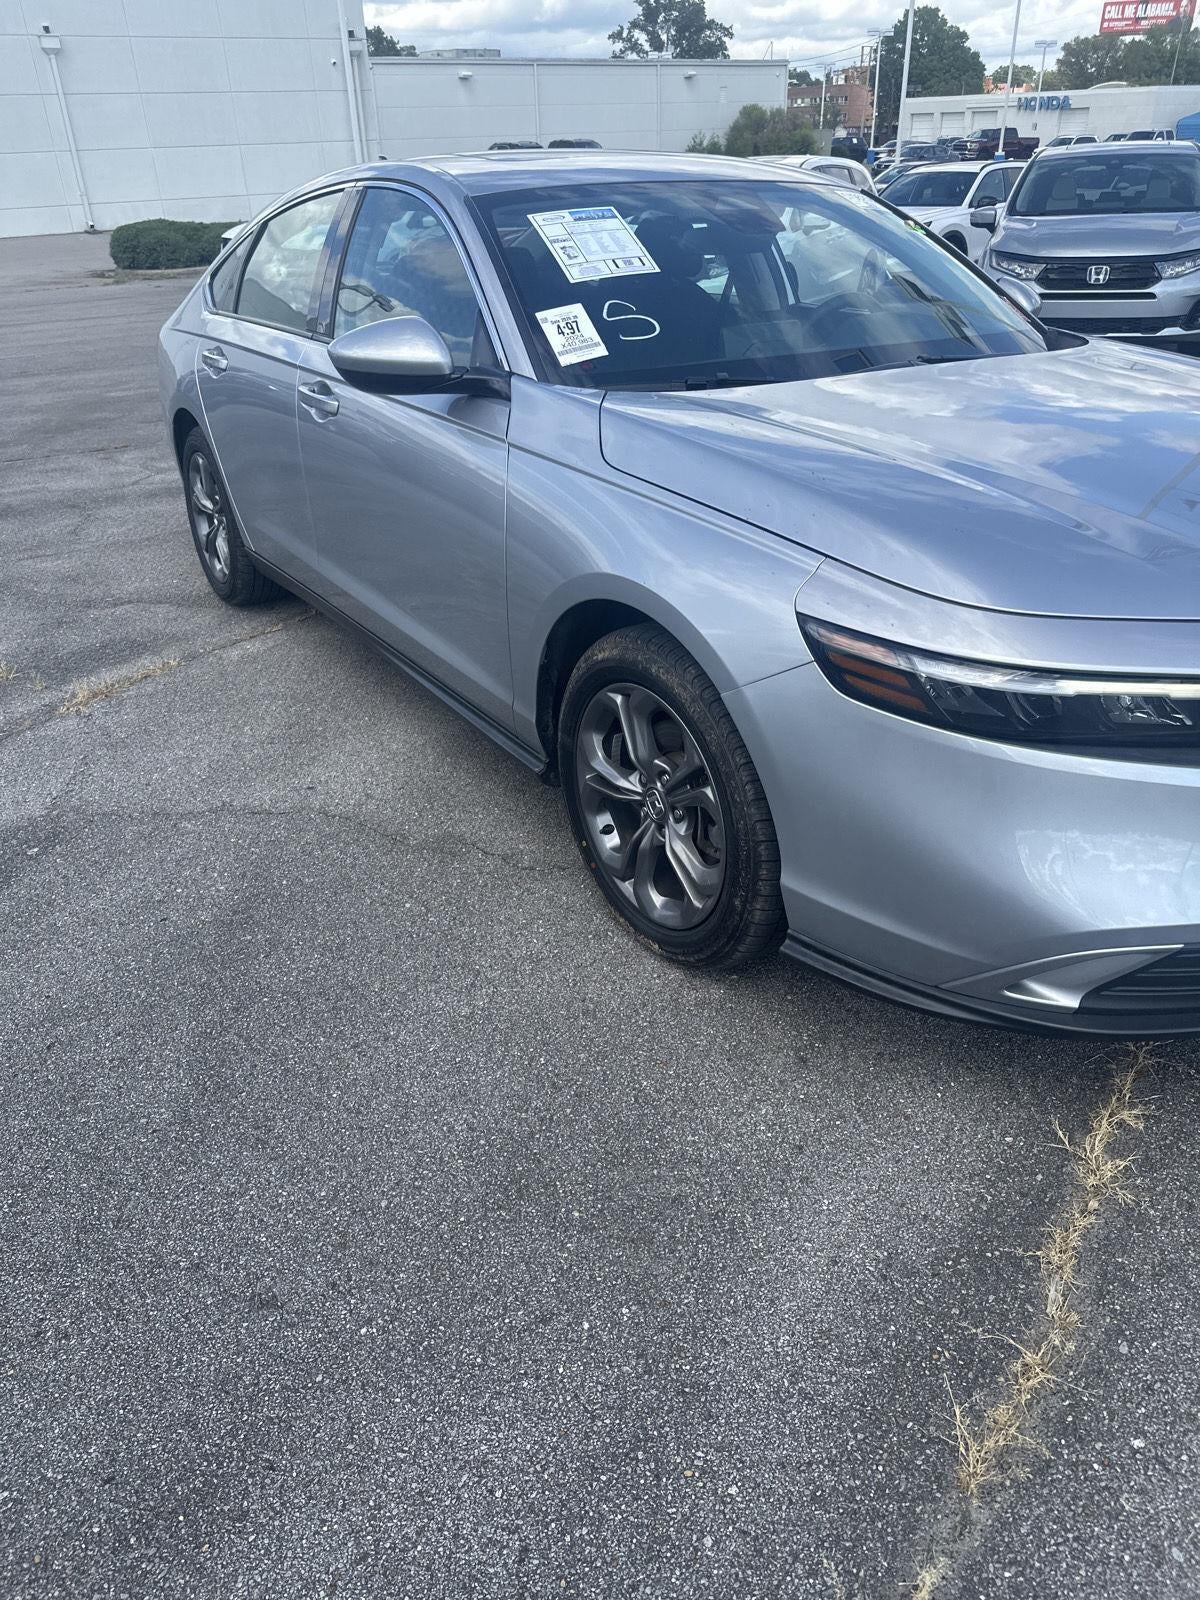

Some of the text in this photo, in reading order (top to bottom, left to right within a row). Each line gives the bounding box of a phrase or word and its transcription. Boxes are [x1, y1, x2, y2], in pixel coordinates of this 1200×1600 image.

[1104, 5, 1123, 19] CALL
[1124, 4, 1137, 18] ME
[1017, 96, 1071, 112] HONDA
[602, 300, 660, 340] S
[557, 320, 581, 337] 4:97
[564, 333, 584, 342] 2024
